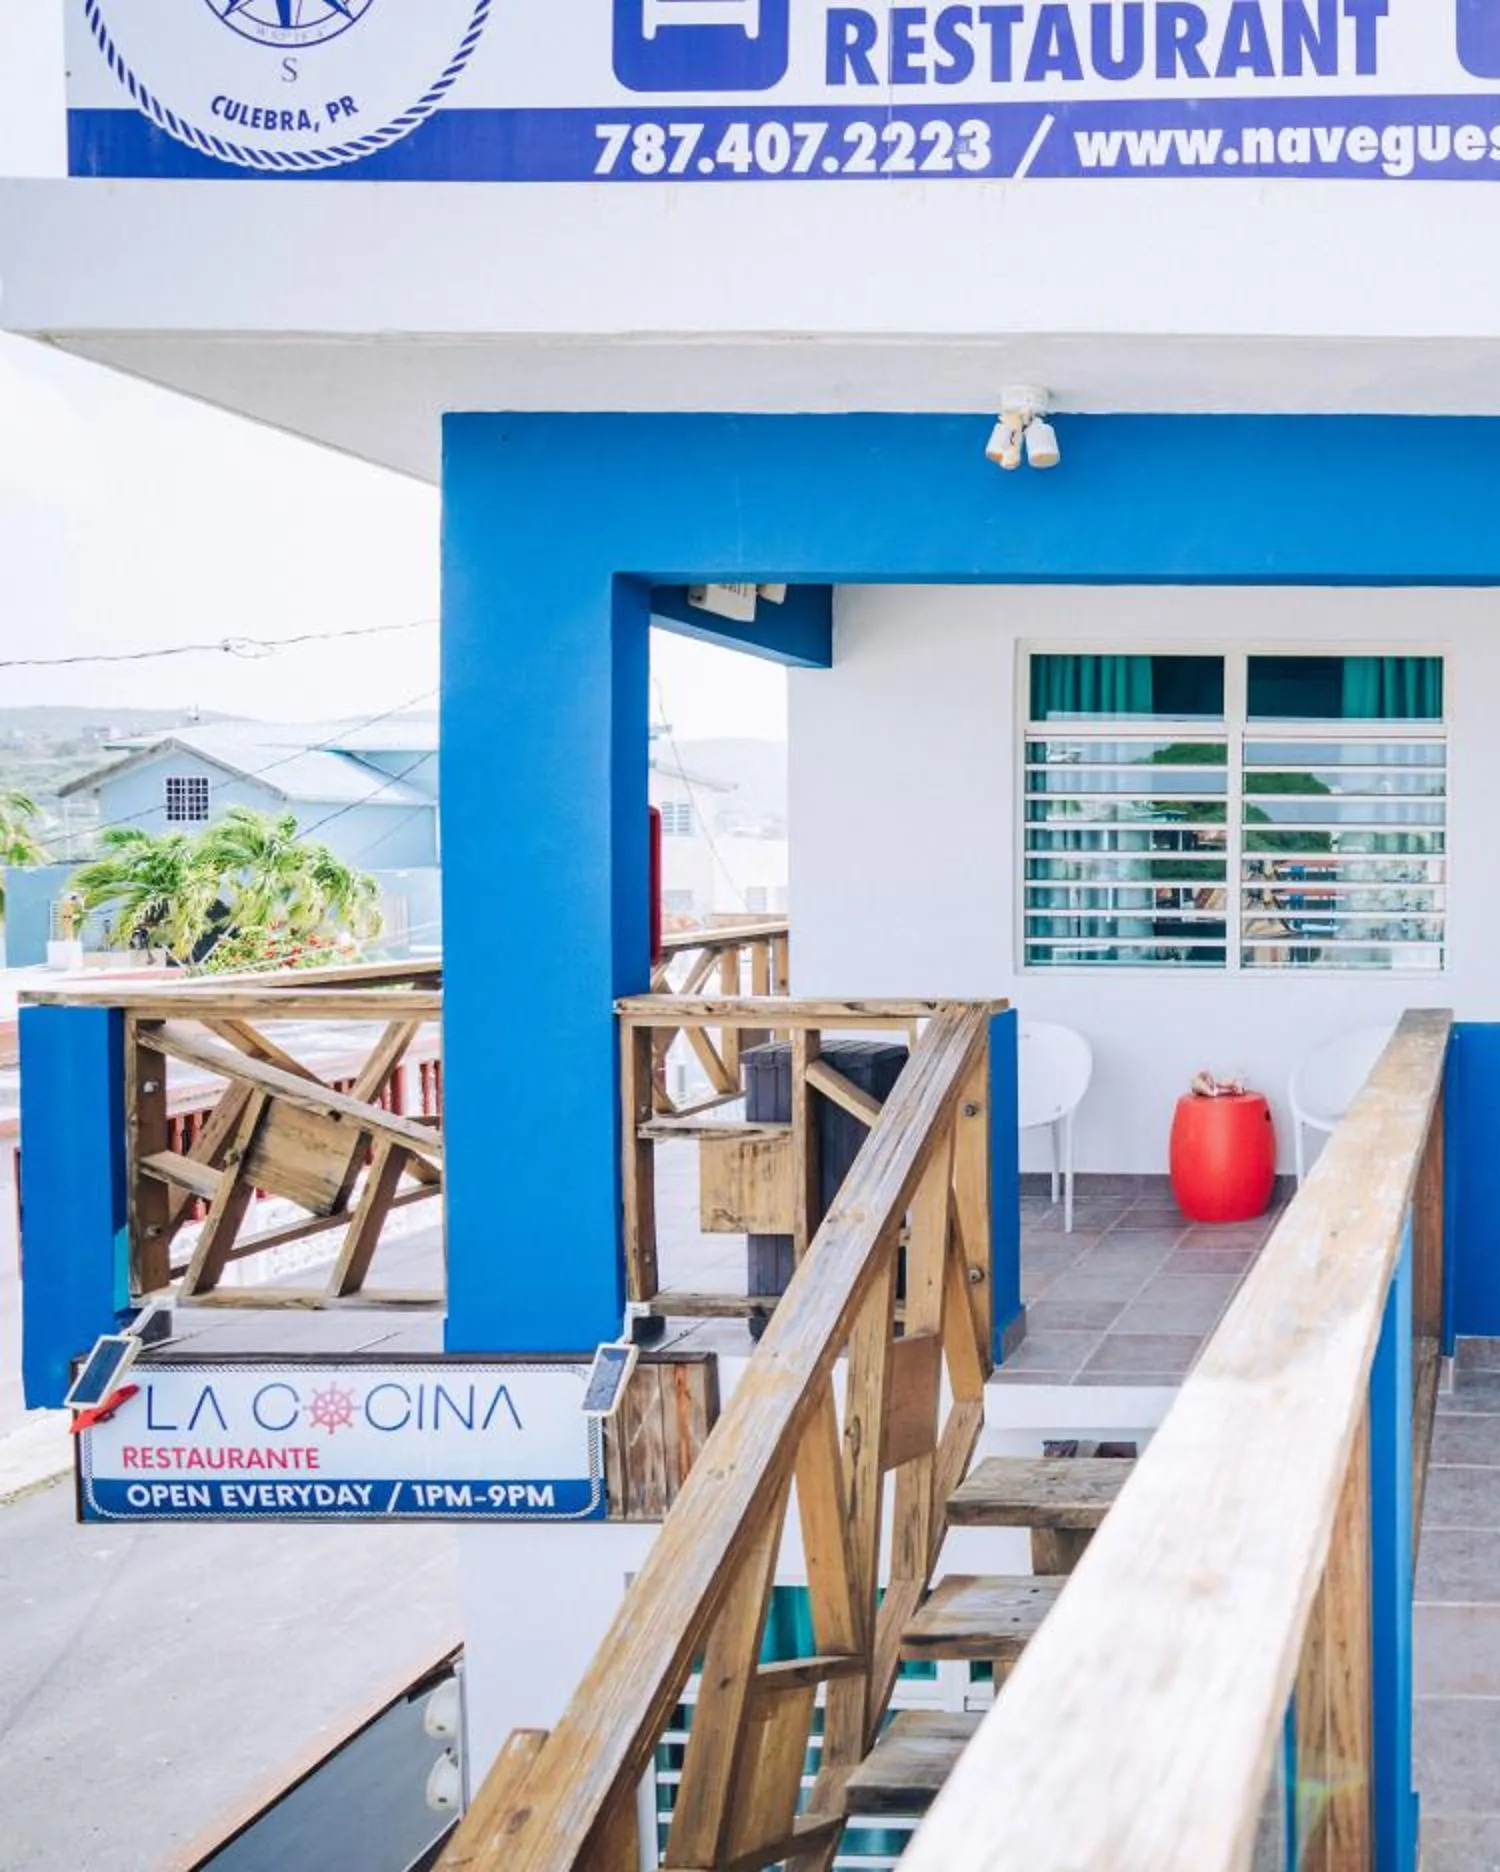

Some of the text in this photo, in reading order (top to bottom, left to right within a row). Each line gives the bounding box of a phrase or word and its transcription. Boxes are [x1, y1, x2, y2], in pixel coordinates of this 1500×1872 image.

[826, 0, 1389, 85] RESTAURANT
[281, 56, 298, 83] S
[211, 95, 360, 133] CULEBRA, PR
[593, 119, 991, 175] 787.407.2223
[147, 1384, 227, 1430] LA
[122, 1446, 320, 1470] RESTAURANTE
[127, 1484, 211, 1507] OPEN
[220, 1483, 373, 1507] EVERYDAY
[412, 1484, 555, 1508] 1PM-9PM
